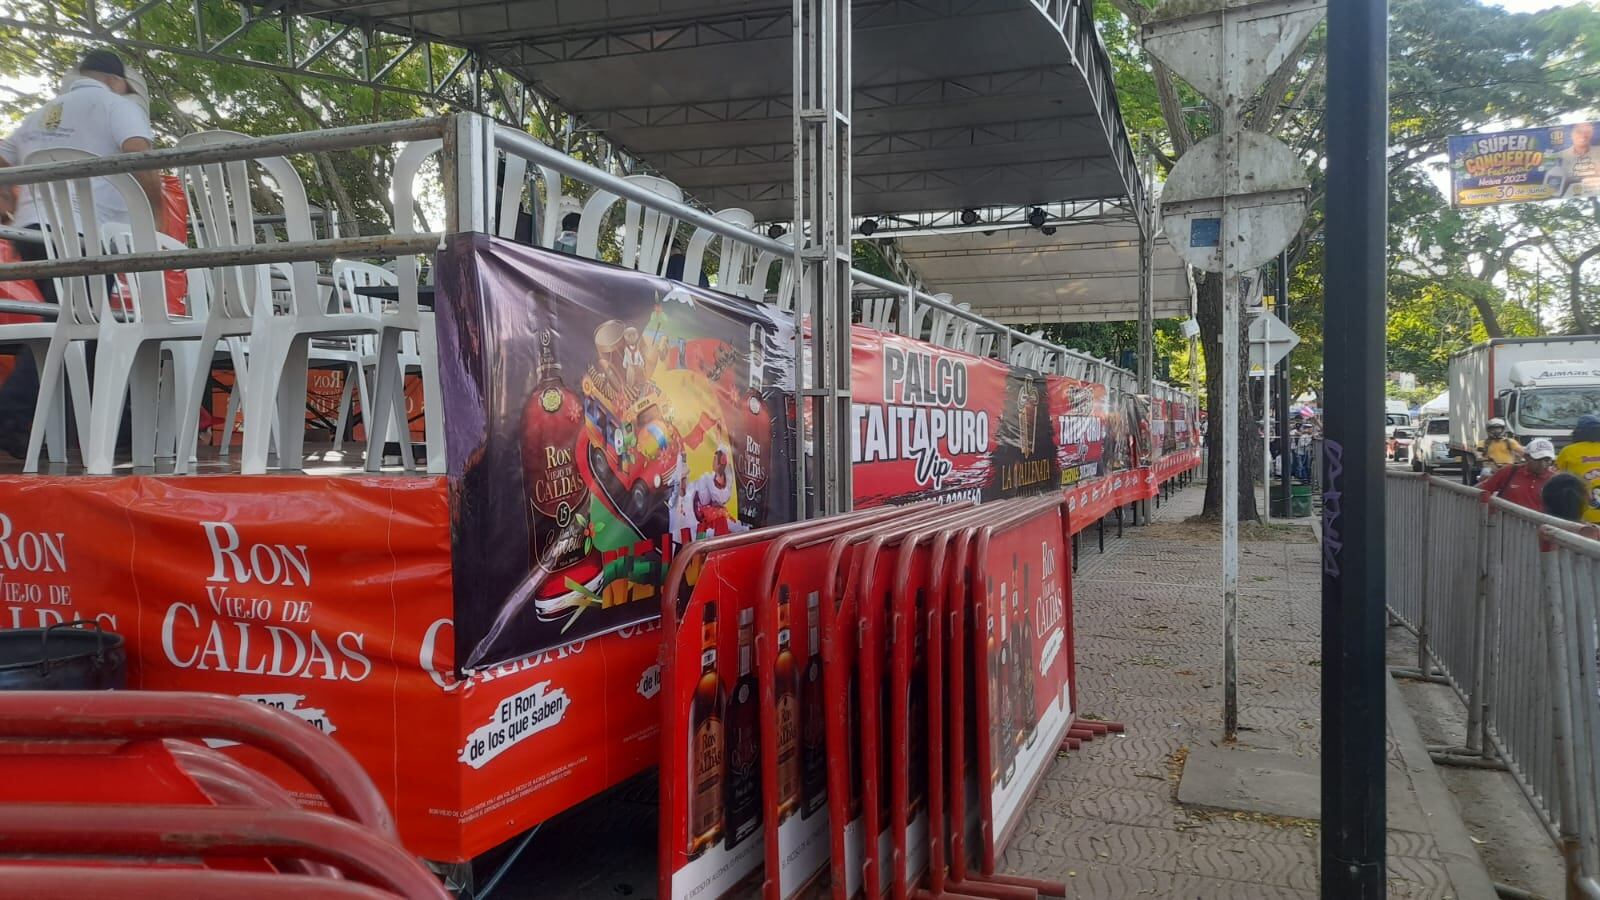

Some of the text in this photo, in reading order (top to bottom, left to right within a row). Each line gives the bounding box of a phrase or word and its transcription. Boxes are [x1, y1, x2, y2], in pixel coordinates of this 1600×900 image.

[1466, 152, 1543, 173] CONCIERTO
[1496, 185, 1514, 199] 30
[1504, 174, 1528, 183] 2023
[883, 342, 967, 408] PALCO
[852, 404, 989, 463] TAITAPURO
[545, 445, 571, 469] RON
[909, 446, 952, 490] Vip
[536, 472, 583, 503] CALDAS
[560, 506, 567, 521] 15
[200, 521, 310, 587] RON
[49, 585, 72, 605] DE
[205, 585, 313, 623] VIEJO DE
[161, 601, 372, 682] CALDAS
[643, 675, 653, 692] de
[502, 693, 536, 724] El Ron
[470, 697, 562, 761] de los que saben
